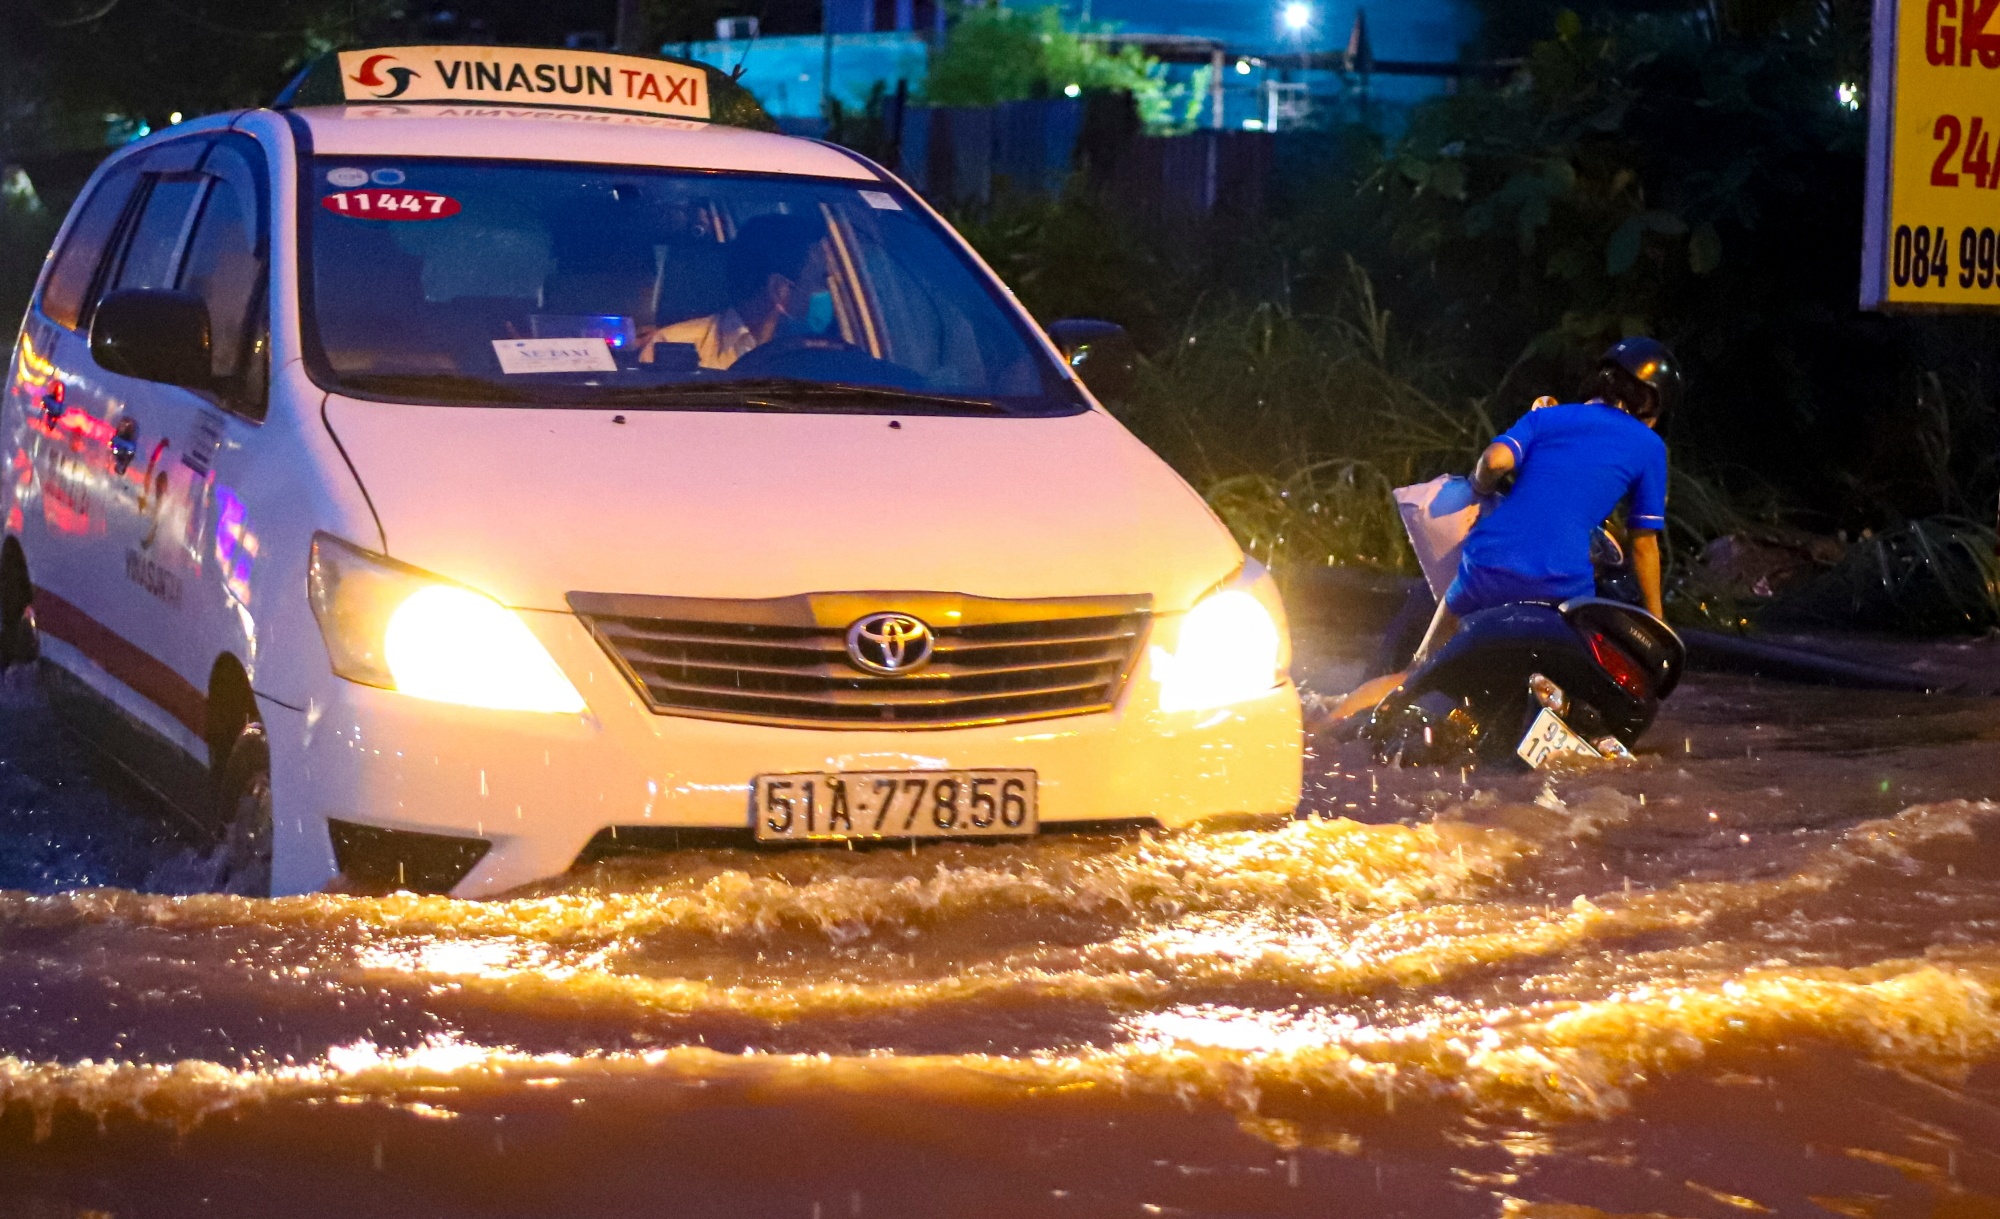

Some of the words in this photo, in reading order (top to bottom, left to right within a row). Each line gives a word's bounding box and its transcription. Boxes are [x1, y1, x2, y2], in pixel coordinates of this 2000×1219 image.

[434, 59, 612, 97] VINASUN
[619, 69, 698, 107] TAXI
[331, 191, 447, 213] 11447
[1893, 224, 1949, 288] 084
[1958, 226, 2000, 290] 99
[766, 777, 1027, 833] 51A-778.56
